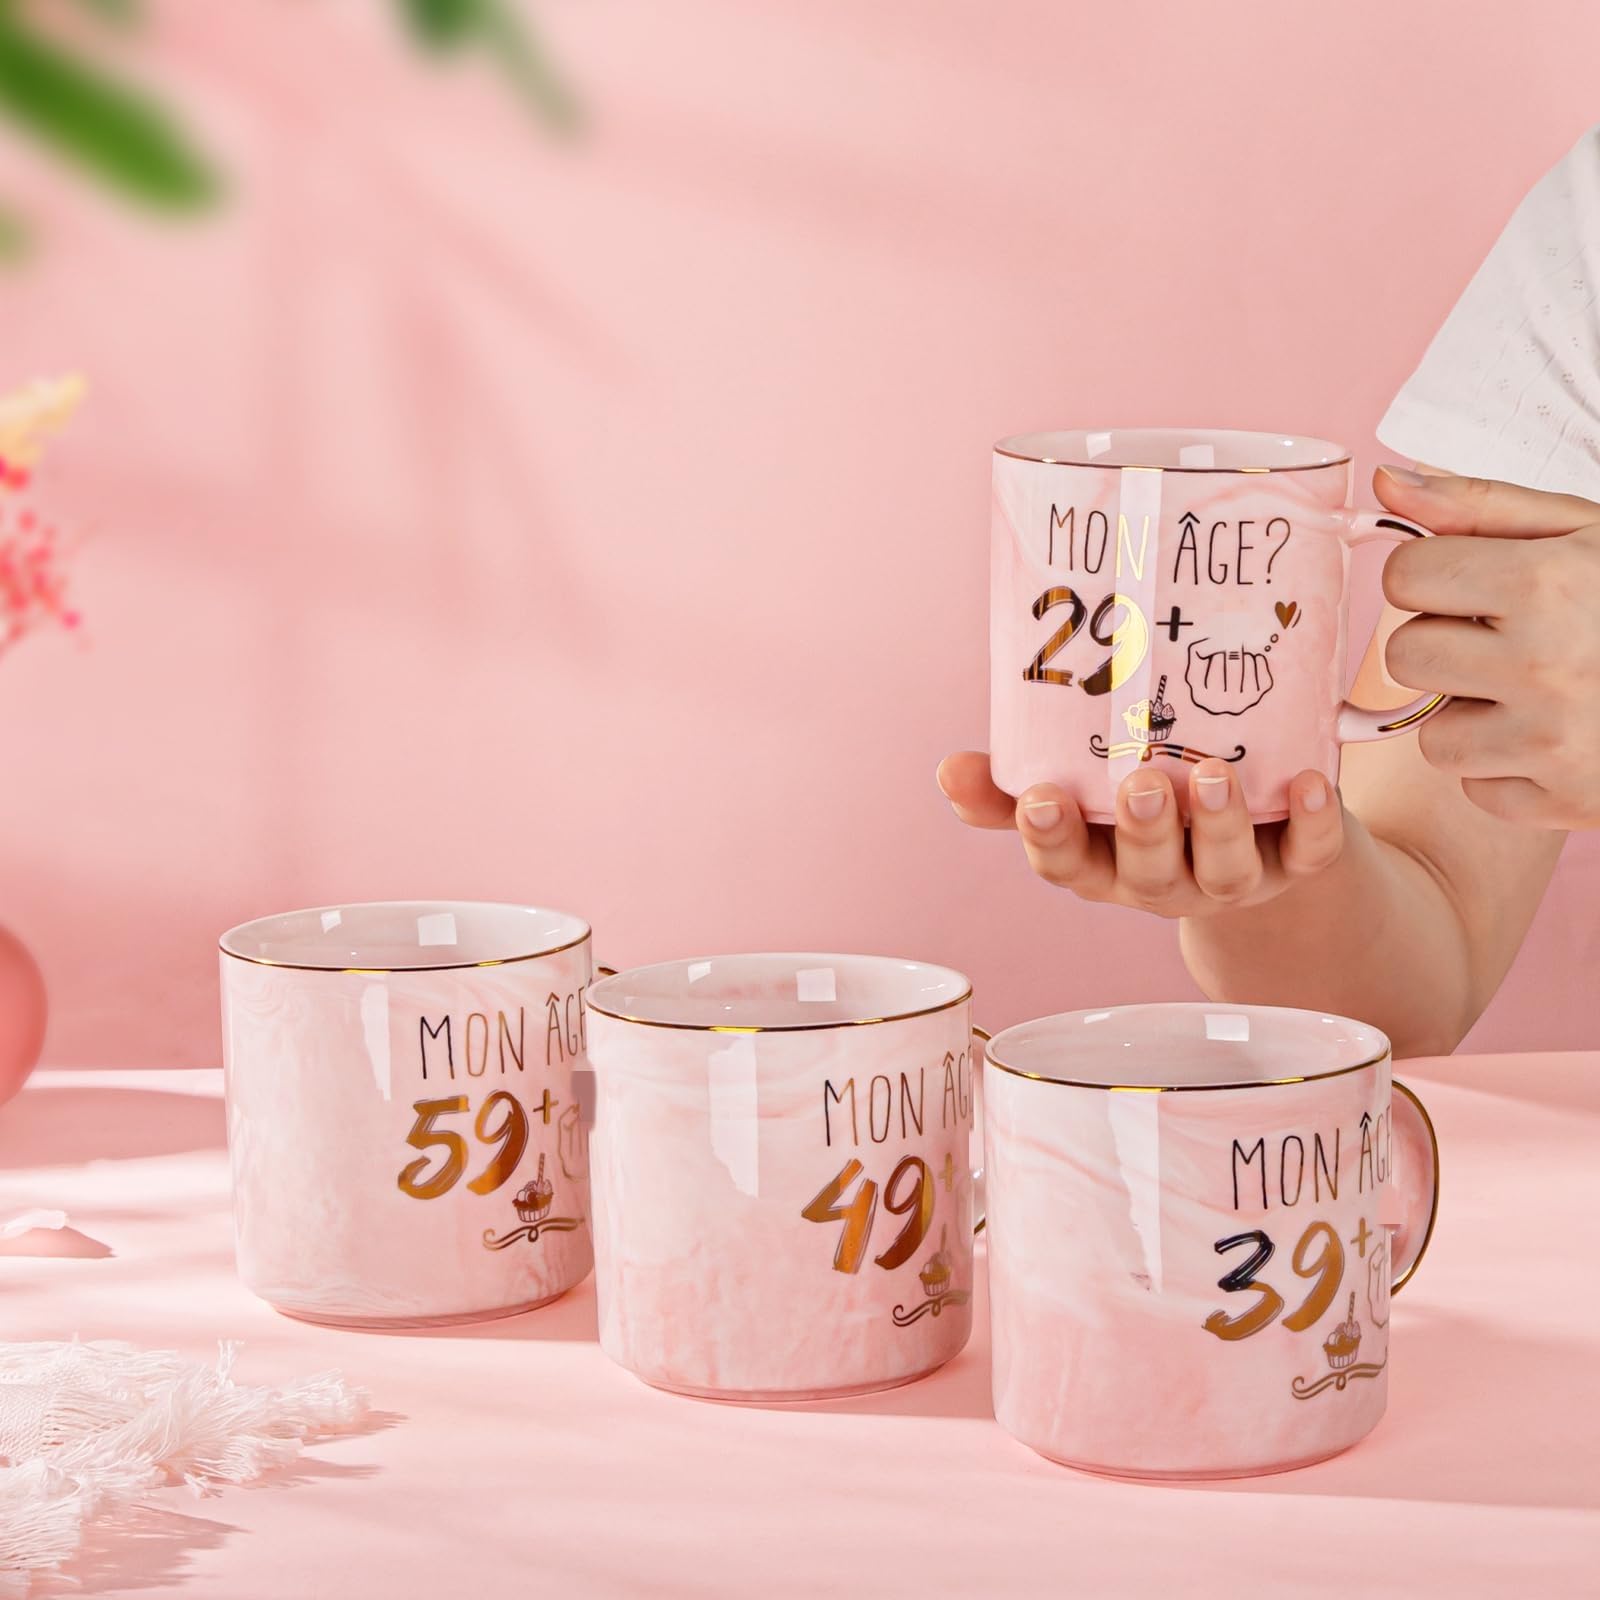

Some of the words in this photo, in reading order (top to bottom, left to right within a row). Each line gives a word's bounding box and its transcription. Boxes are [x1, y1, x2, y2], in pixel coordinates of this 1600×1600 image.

[1048, 502, 1149, 581] MON
[1173, 510, 1292, 586] ÂGE?
[419, 1005, 526, 1080] MON
[545, 978, 592, 1066] ÂGE
[824, 1066, 925, 1147] MON
[1232, 1127, 1340, 1211] MON
